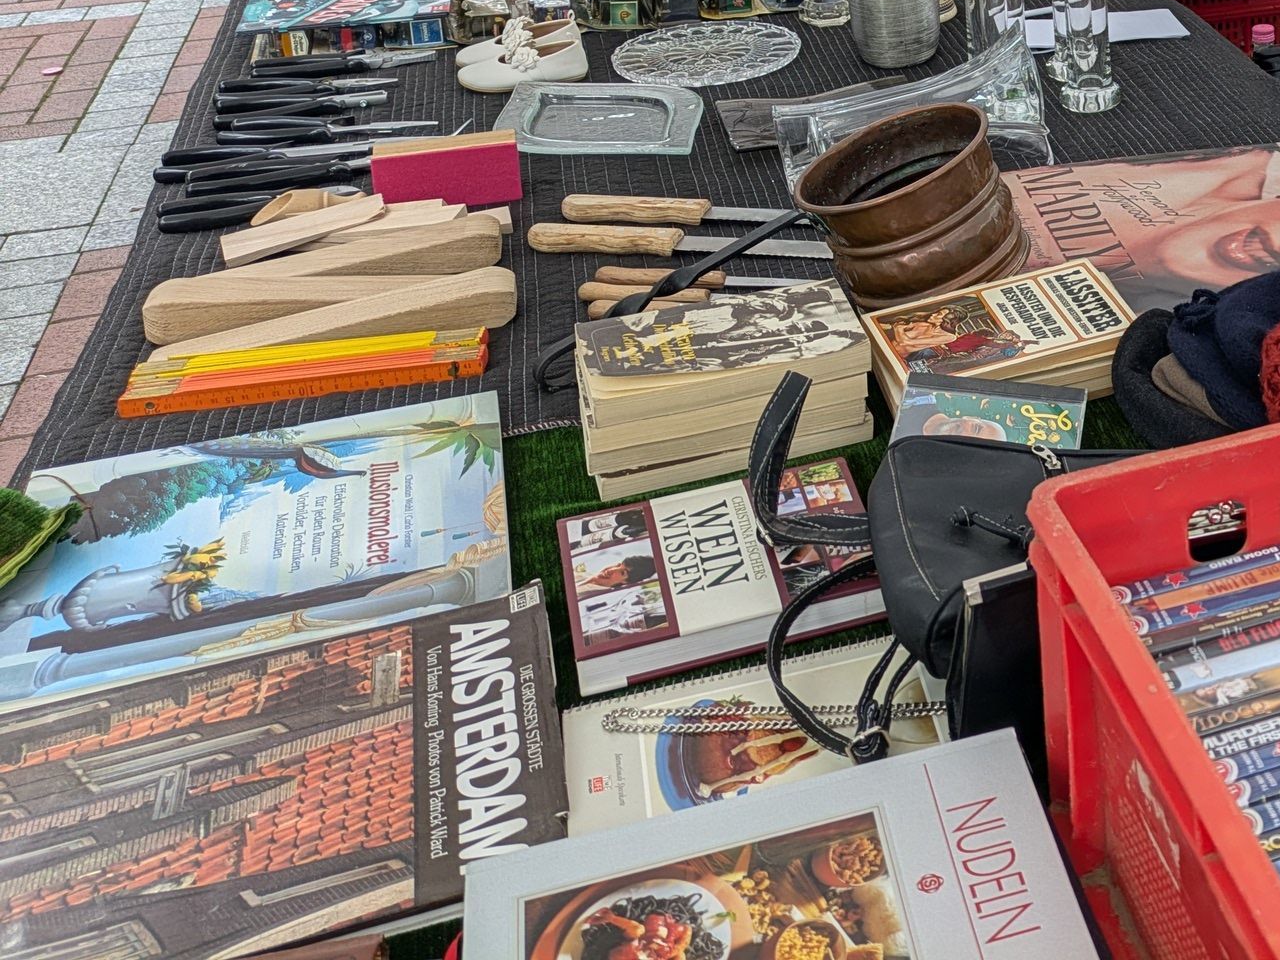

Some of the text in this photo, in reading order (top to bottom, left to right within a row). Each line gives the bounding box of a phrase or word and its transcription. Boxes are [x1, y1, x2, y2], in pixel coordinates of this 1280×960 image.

[1016, 167, 1144, 282] MARILYN
[1119, 178, 1195, 217] Bernard
[996, 302, 1008, 314] JACK
[1000, 287, 1050, 340] DESPERADO-LADY
[1014, 282, 1066, 338] LASSITER UND DIE
[1053, 270, 1122, 332] LASSITER
[272, 512, 290, 560] Materialien
[288, 492, 310, 574] Vorbilder, Techniken,
[312, 496, 328, 556] für jeden Raum
[330, 483, 346, 569] Effektvolle Dekoration
[366, 460, 400, 567] Illusionsmalerei
[688, 499, 750, 590] WEIN
[732, 496, 768, 581] CHRISTINA FISCHERS
[659, 510, 706, 596] WISSEN
[1207, 553, 1242, 572] BANG
[1243, 544, 1278, 562] BOOM
[516, 592, 528, 612] LIFE
[424, 645, 448, 860] Von Hans Koning Photos von Patrick Ward
[450, 618, 530, 876] AMSTERDAM
[519, 663, 544, 773] DIE GROSSEN STÄDTE
[1216, 740, 1244, 759] THE
[946, 796, 1041, 944] NUDELN
